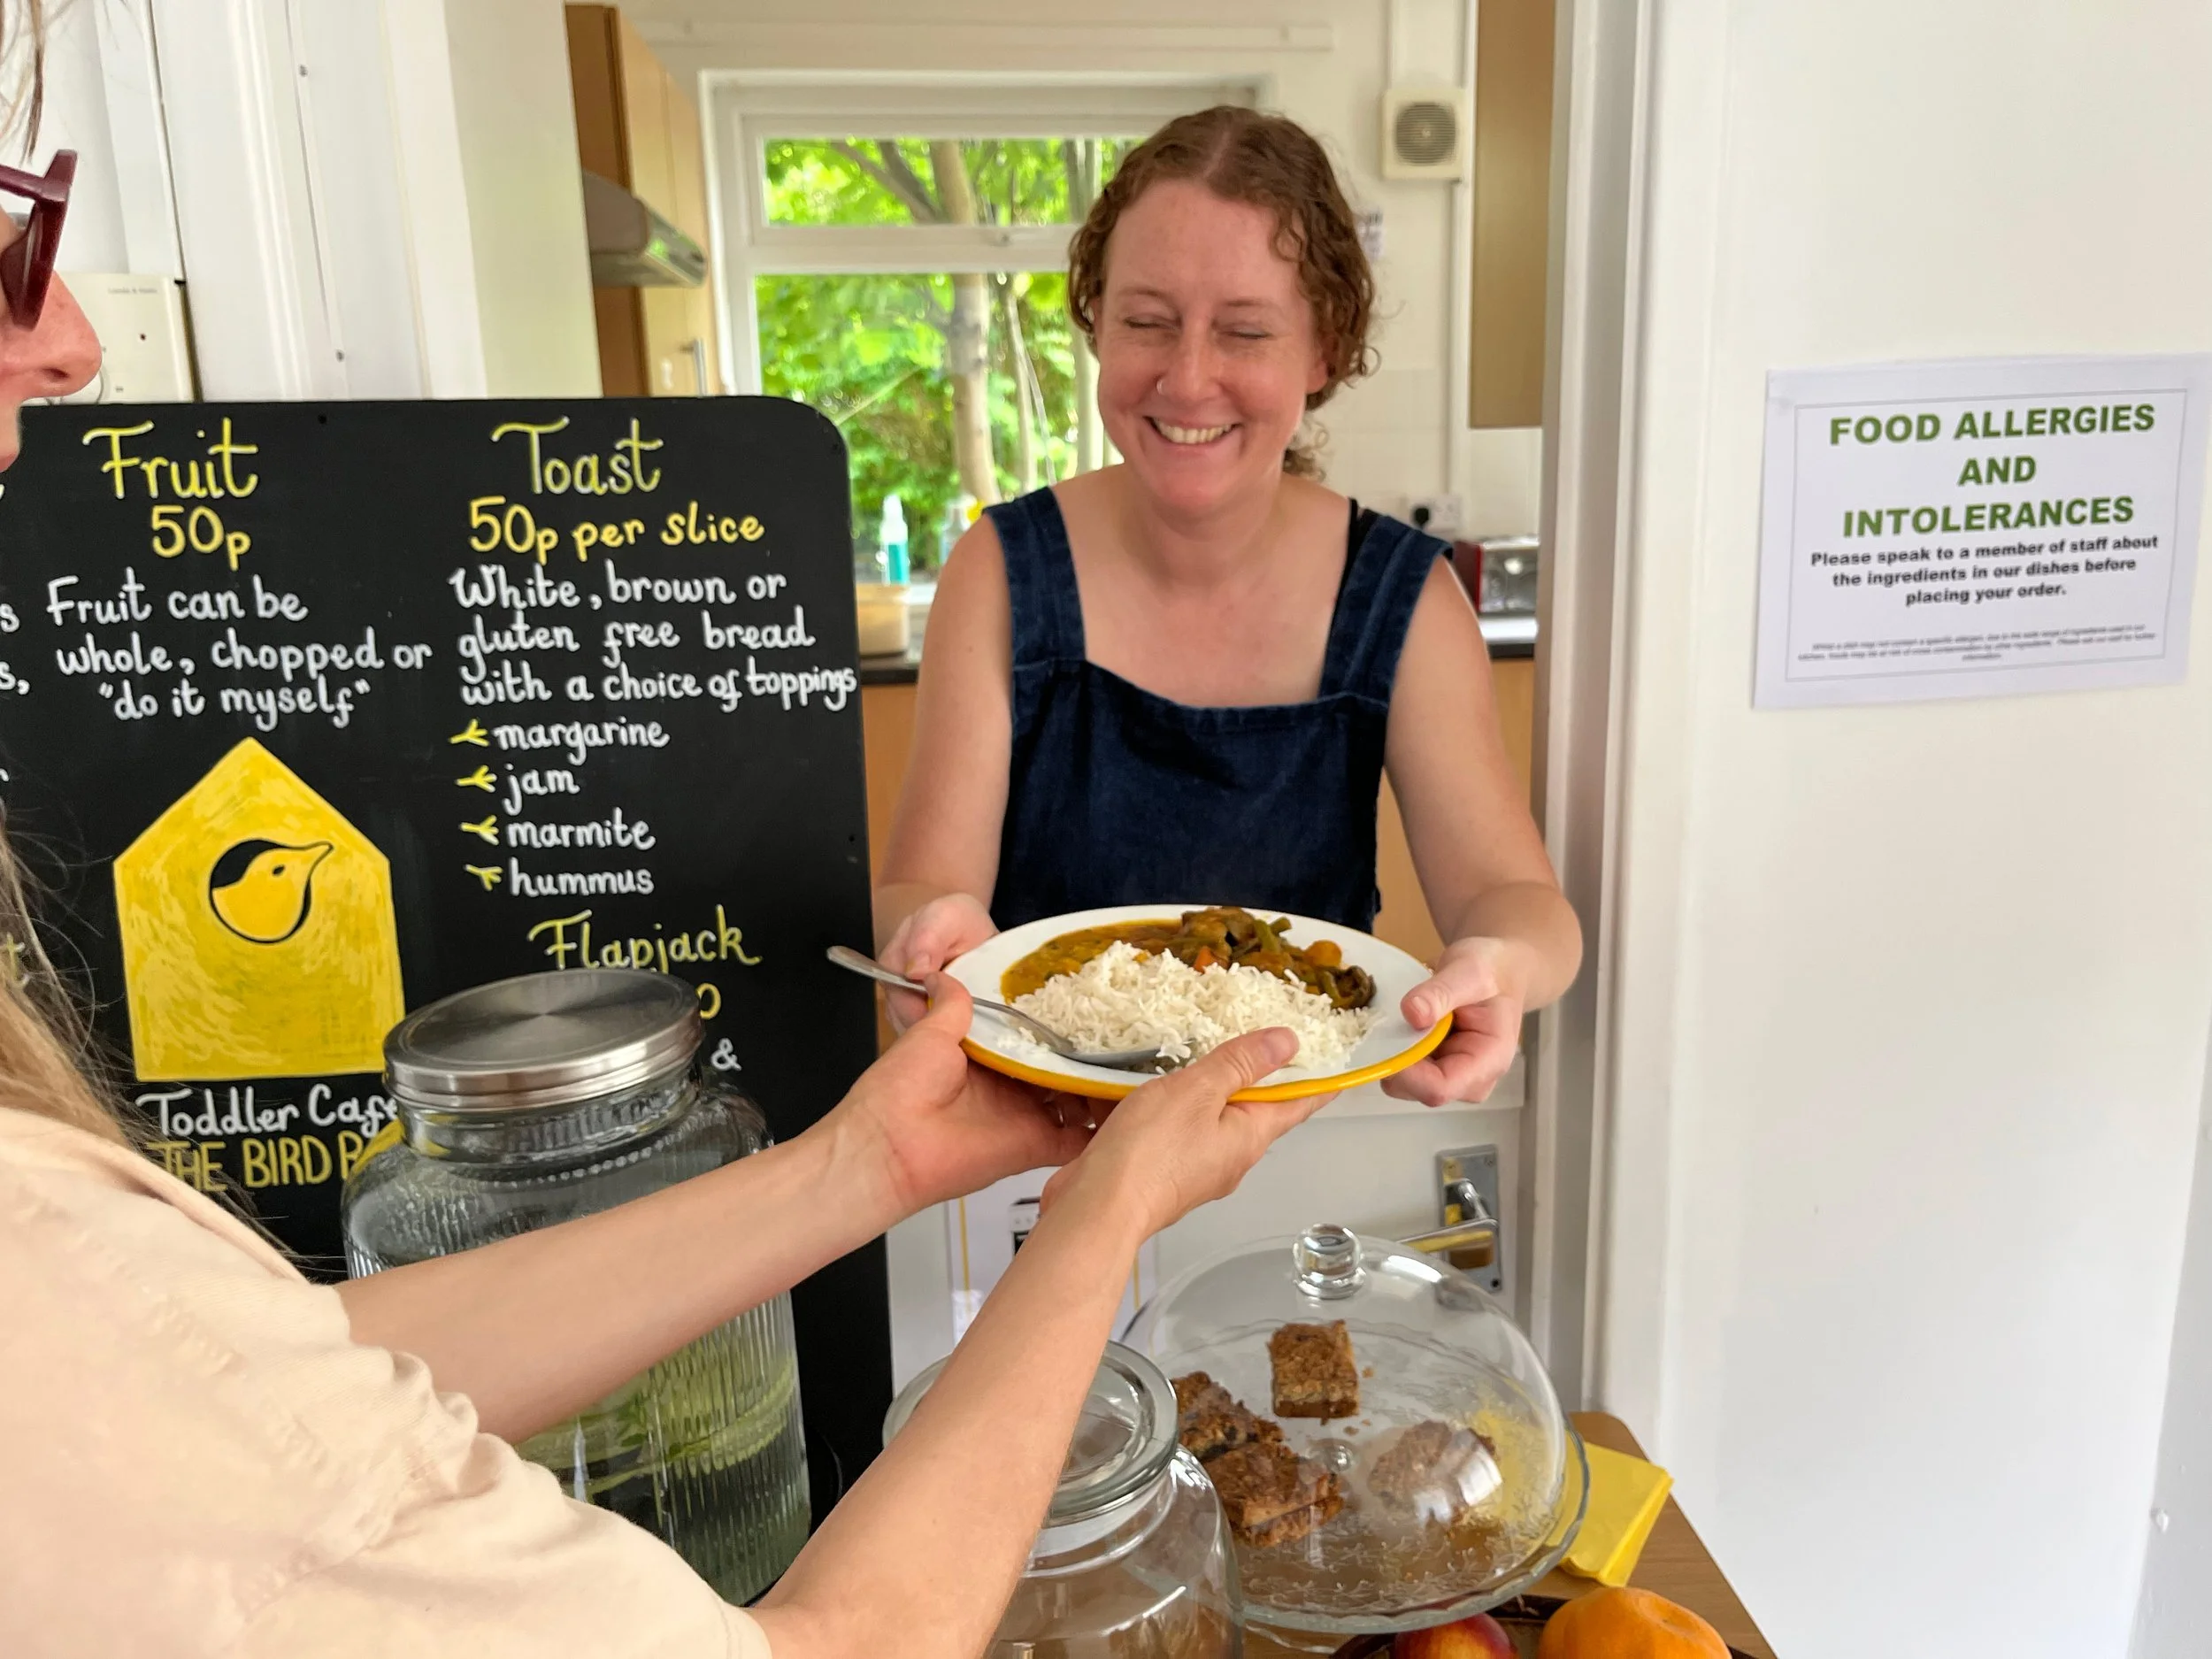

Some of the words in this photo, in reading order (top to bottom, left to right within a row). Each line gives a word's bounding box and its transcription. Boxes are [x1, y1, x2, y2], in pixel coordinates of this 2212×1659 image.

[1830, 412, 1941, 445] FOOD
[1954, 403, 2155, 440] ALLERGIES
[83, 417, 258, 499] Fruit
[491, 416, 664, 495] Toast
[1957, 456, 2037, 486] AND
[150, 505, 251, 571] 50p
[469, 495, 559, 565] 50p
[572, 518, 645, 562] per
[660, 501, 764, 545] slice
[1843, 496, 2134, 538] INTOLERANCES
[1811, 552, 1871, 566] Please
[1878, 547, 1930, 565] speak
[1937, 547, 1954, 560] to
[1960, 548, 1970, 559] a
[1976, 541, 2043, 558] member
[2049, 539, 2066, 553] of
[2070, 536, 2108, 553] staff
[2113, 534, 2158, 549] about
[1833, 572, 1862, 587] the
[1868, 567, 1967, 588] ingredients
[1973, 565, 1988, 580] in
[1993, 565, 2021, 578] our
[2026, 561, 2079, 576] dishes
[2085, 557, 2136, 572] before
[47, 566, 151, 626] Fruit
[168, 587, 246, 620] can
[252, 574, 309, 621] be
[448, 564, 602, 610] White,
[605, 558, 737, 604] brown
[746, 572, 787, 600] or
[1906, 588, 1970, 607] placing
[1976, 586, 2012, 603] your
[2017, 582, 2066, 597] order.
[57, 633, 196, 675] whole,
[211, 626, 385, 681] chopped
[393, 643, 433, 670] or
[458, 608, 580, 684] gluten
[603, 620, 680, 669] free
[702, 604, 816, 649] bread
[172, 678, 205, 718] it
[461, 657, 552, 705] with
[565, 674, 594, 702] a
[602, 663, 703, 702] choice
[708, 669, 742, 712] of
[746, 657, 857, 710] toppings
[493, 716, 670, 766] margarine
[503, 764, 580, 815] jam
[507, 807, 657, 850] marmite
[509, 857, 654, 896] hummus
[526, 904, 762, 975] Flapjack
[134, 1086, 300, 1137] Toddler
[147, 1140, 227, 1192] THE
[242, 1134, 333, 1188] BIRD
